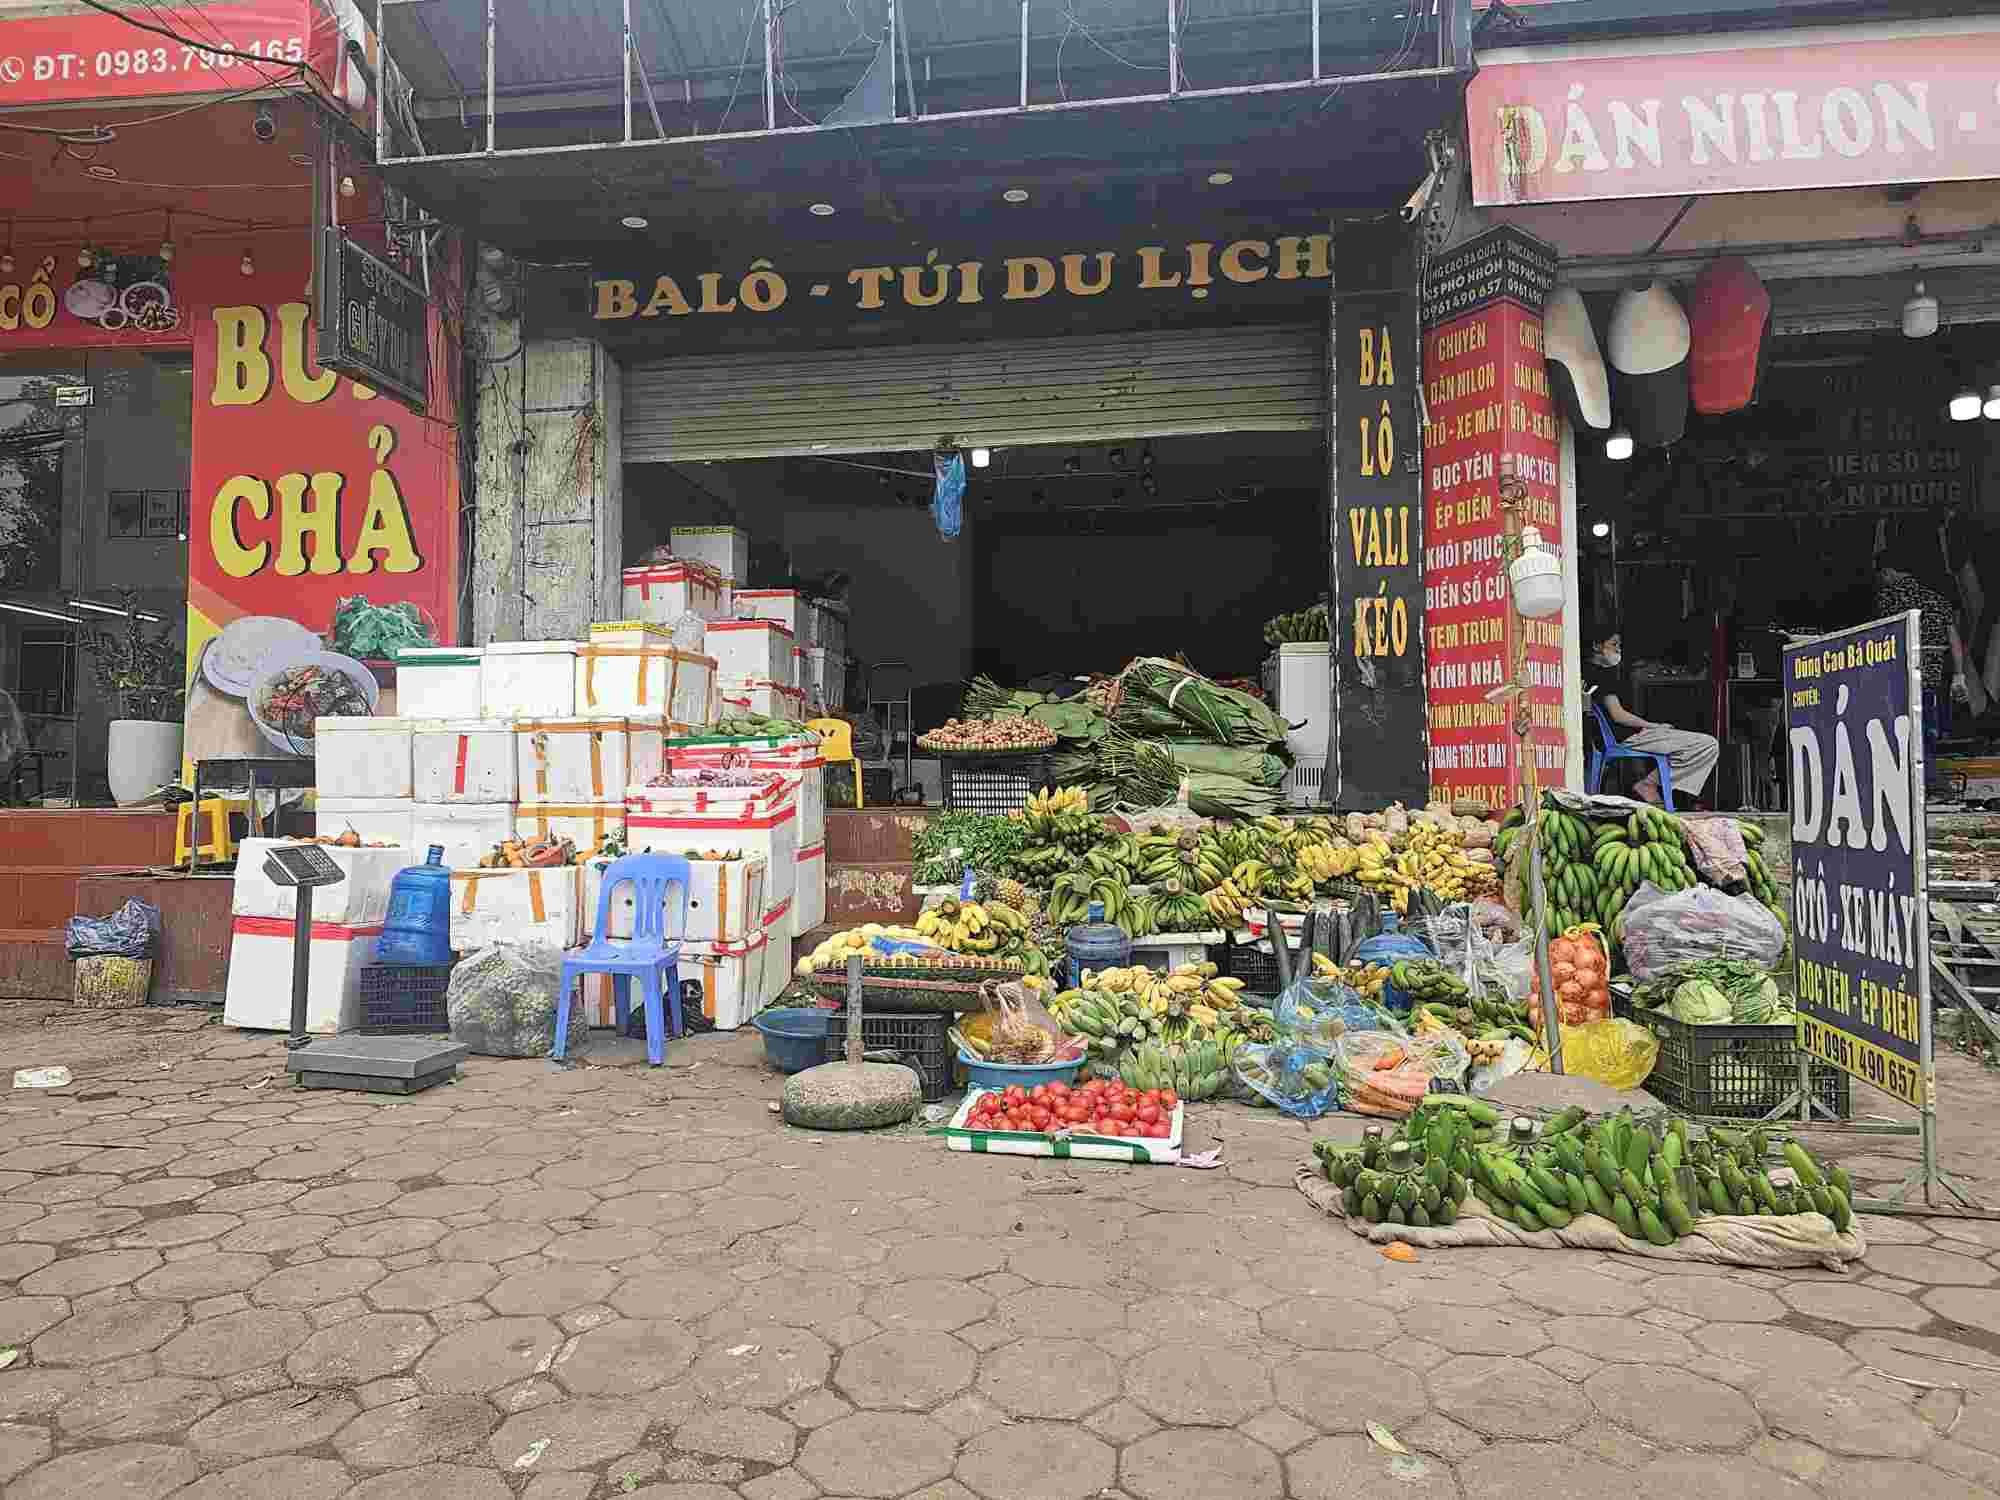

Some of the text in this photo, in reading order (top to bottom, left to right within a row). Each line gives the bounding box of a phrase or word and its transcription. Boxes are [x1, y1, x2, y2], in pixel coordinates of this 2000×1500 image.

[33, 54, 85, 81] ĐT:
[1494, 83, 1664, 177] DÁN
[1680, 81, 1936, 167] NILON
[847, 248, 984, 310] TÚI
[1002, 252, 1116, 300] DU
[1136, 234, 1333, 299] LỊCH
[1359, 399, 1394, 477] LÔ
[1456, 414, 1473, 440] XE
[210, 424, 422, 577] CHẢ
[1432, 461, 1461, 493] BỌC
[1349, 507, 1409, 567] VALI
[1463, 534, 1504, 566] PHỤC
[1354, 578, 1409, 657] KÉO
[1429, 623, 1458, 650] TEM
[1430, 661, 1467, 689] KÍNH
[1823, 650, 1845, 673] Cao
[1865, 634, 1897, 667] Quát
[1474, 743, 1487, 768] XE
[1790, 684, 1911, 855] DÁN
[1489, 784, 1505, 809] XE
[1796, 857, 1829, 943] ÔTÔ
[1840, 884, 1867, 955] XE
[1868, 871, 1916, 969] MÁY
[1800, 958, 1823, 1010] BỌC
[1860, 969, 1878, 1026] ÉP
[1881, 973, 1920, 1045] BIỂN
[1824, 1030, 1855, 1071] 0961
[1858, 1044, 1885, 1085] 490
[1888, 1059, 1917, 1101] 657
